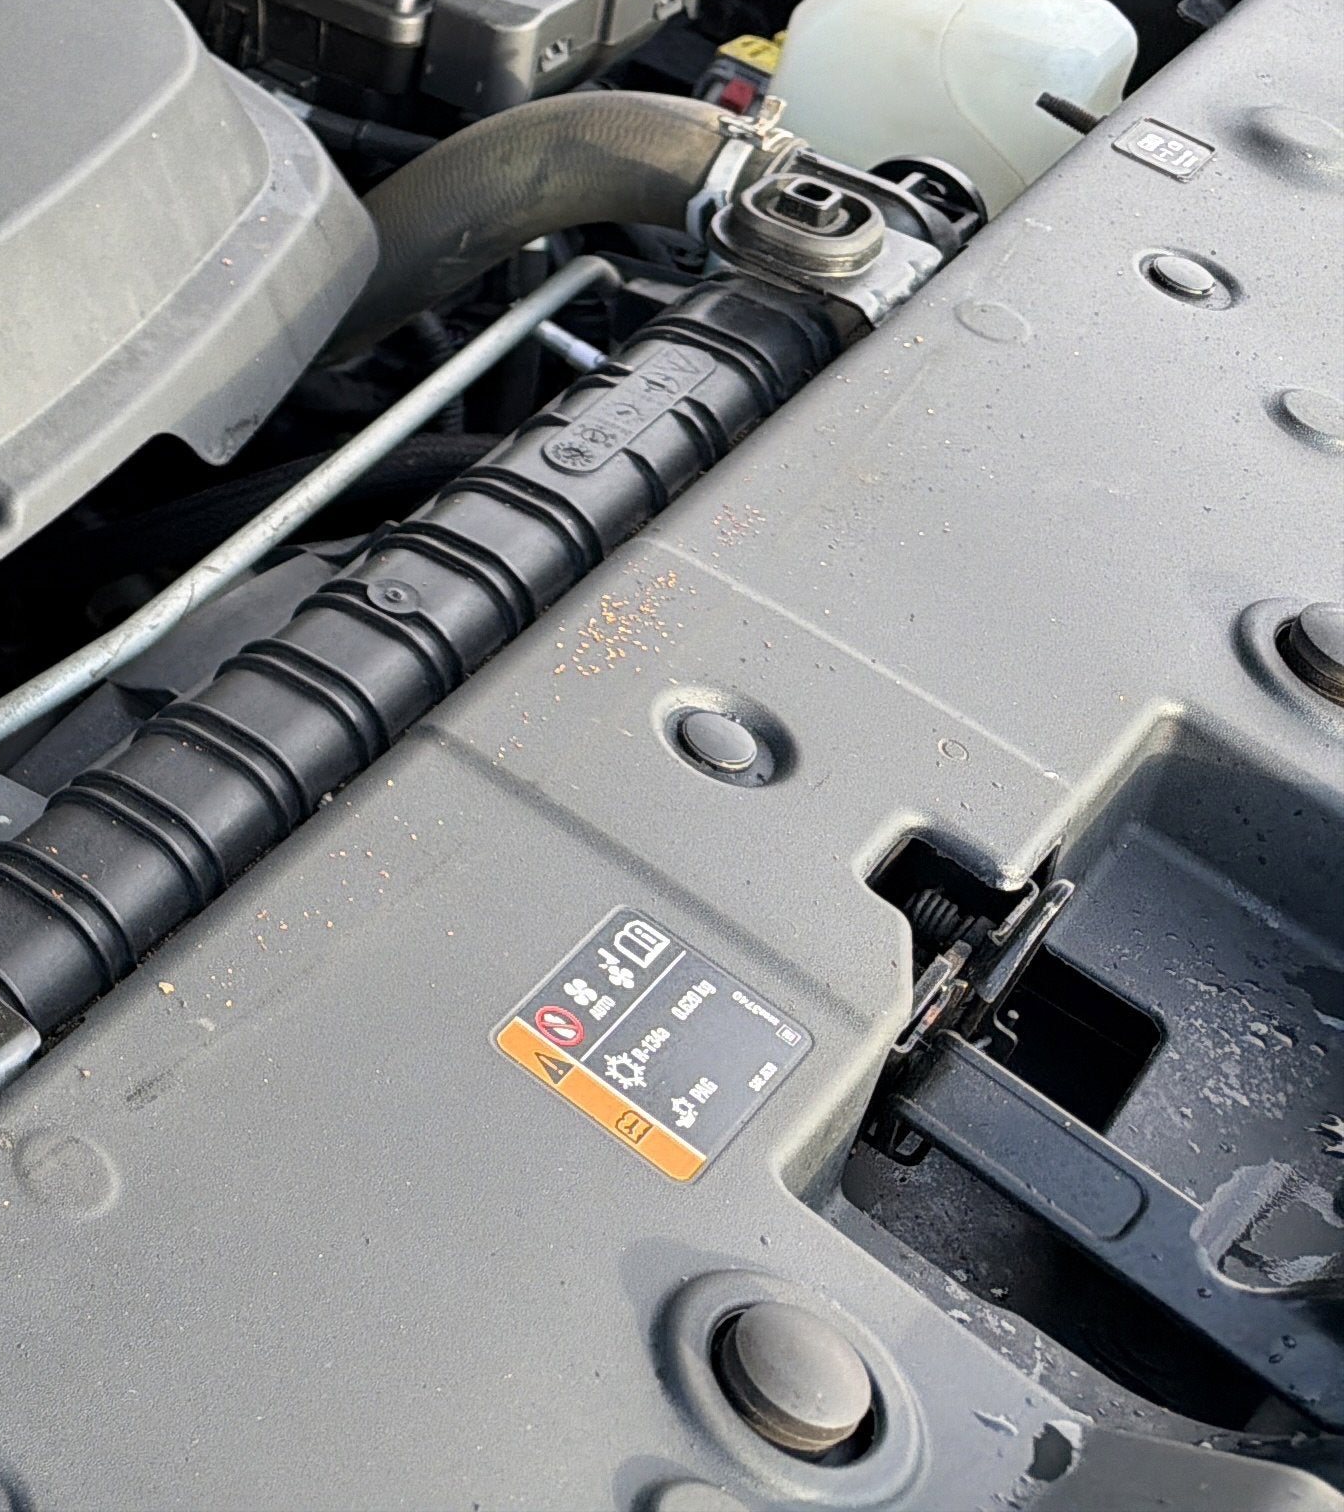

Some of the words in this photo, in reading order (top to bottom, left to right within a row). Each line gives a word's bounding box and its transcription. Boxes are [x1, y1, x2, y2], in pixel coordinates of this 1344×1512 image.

[588, 995, 616, 1021] AUTO
[630, 1027, 671, 1064] R-134a
[688, 1077, 719, 1104] PAG
